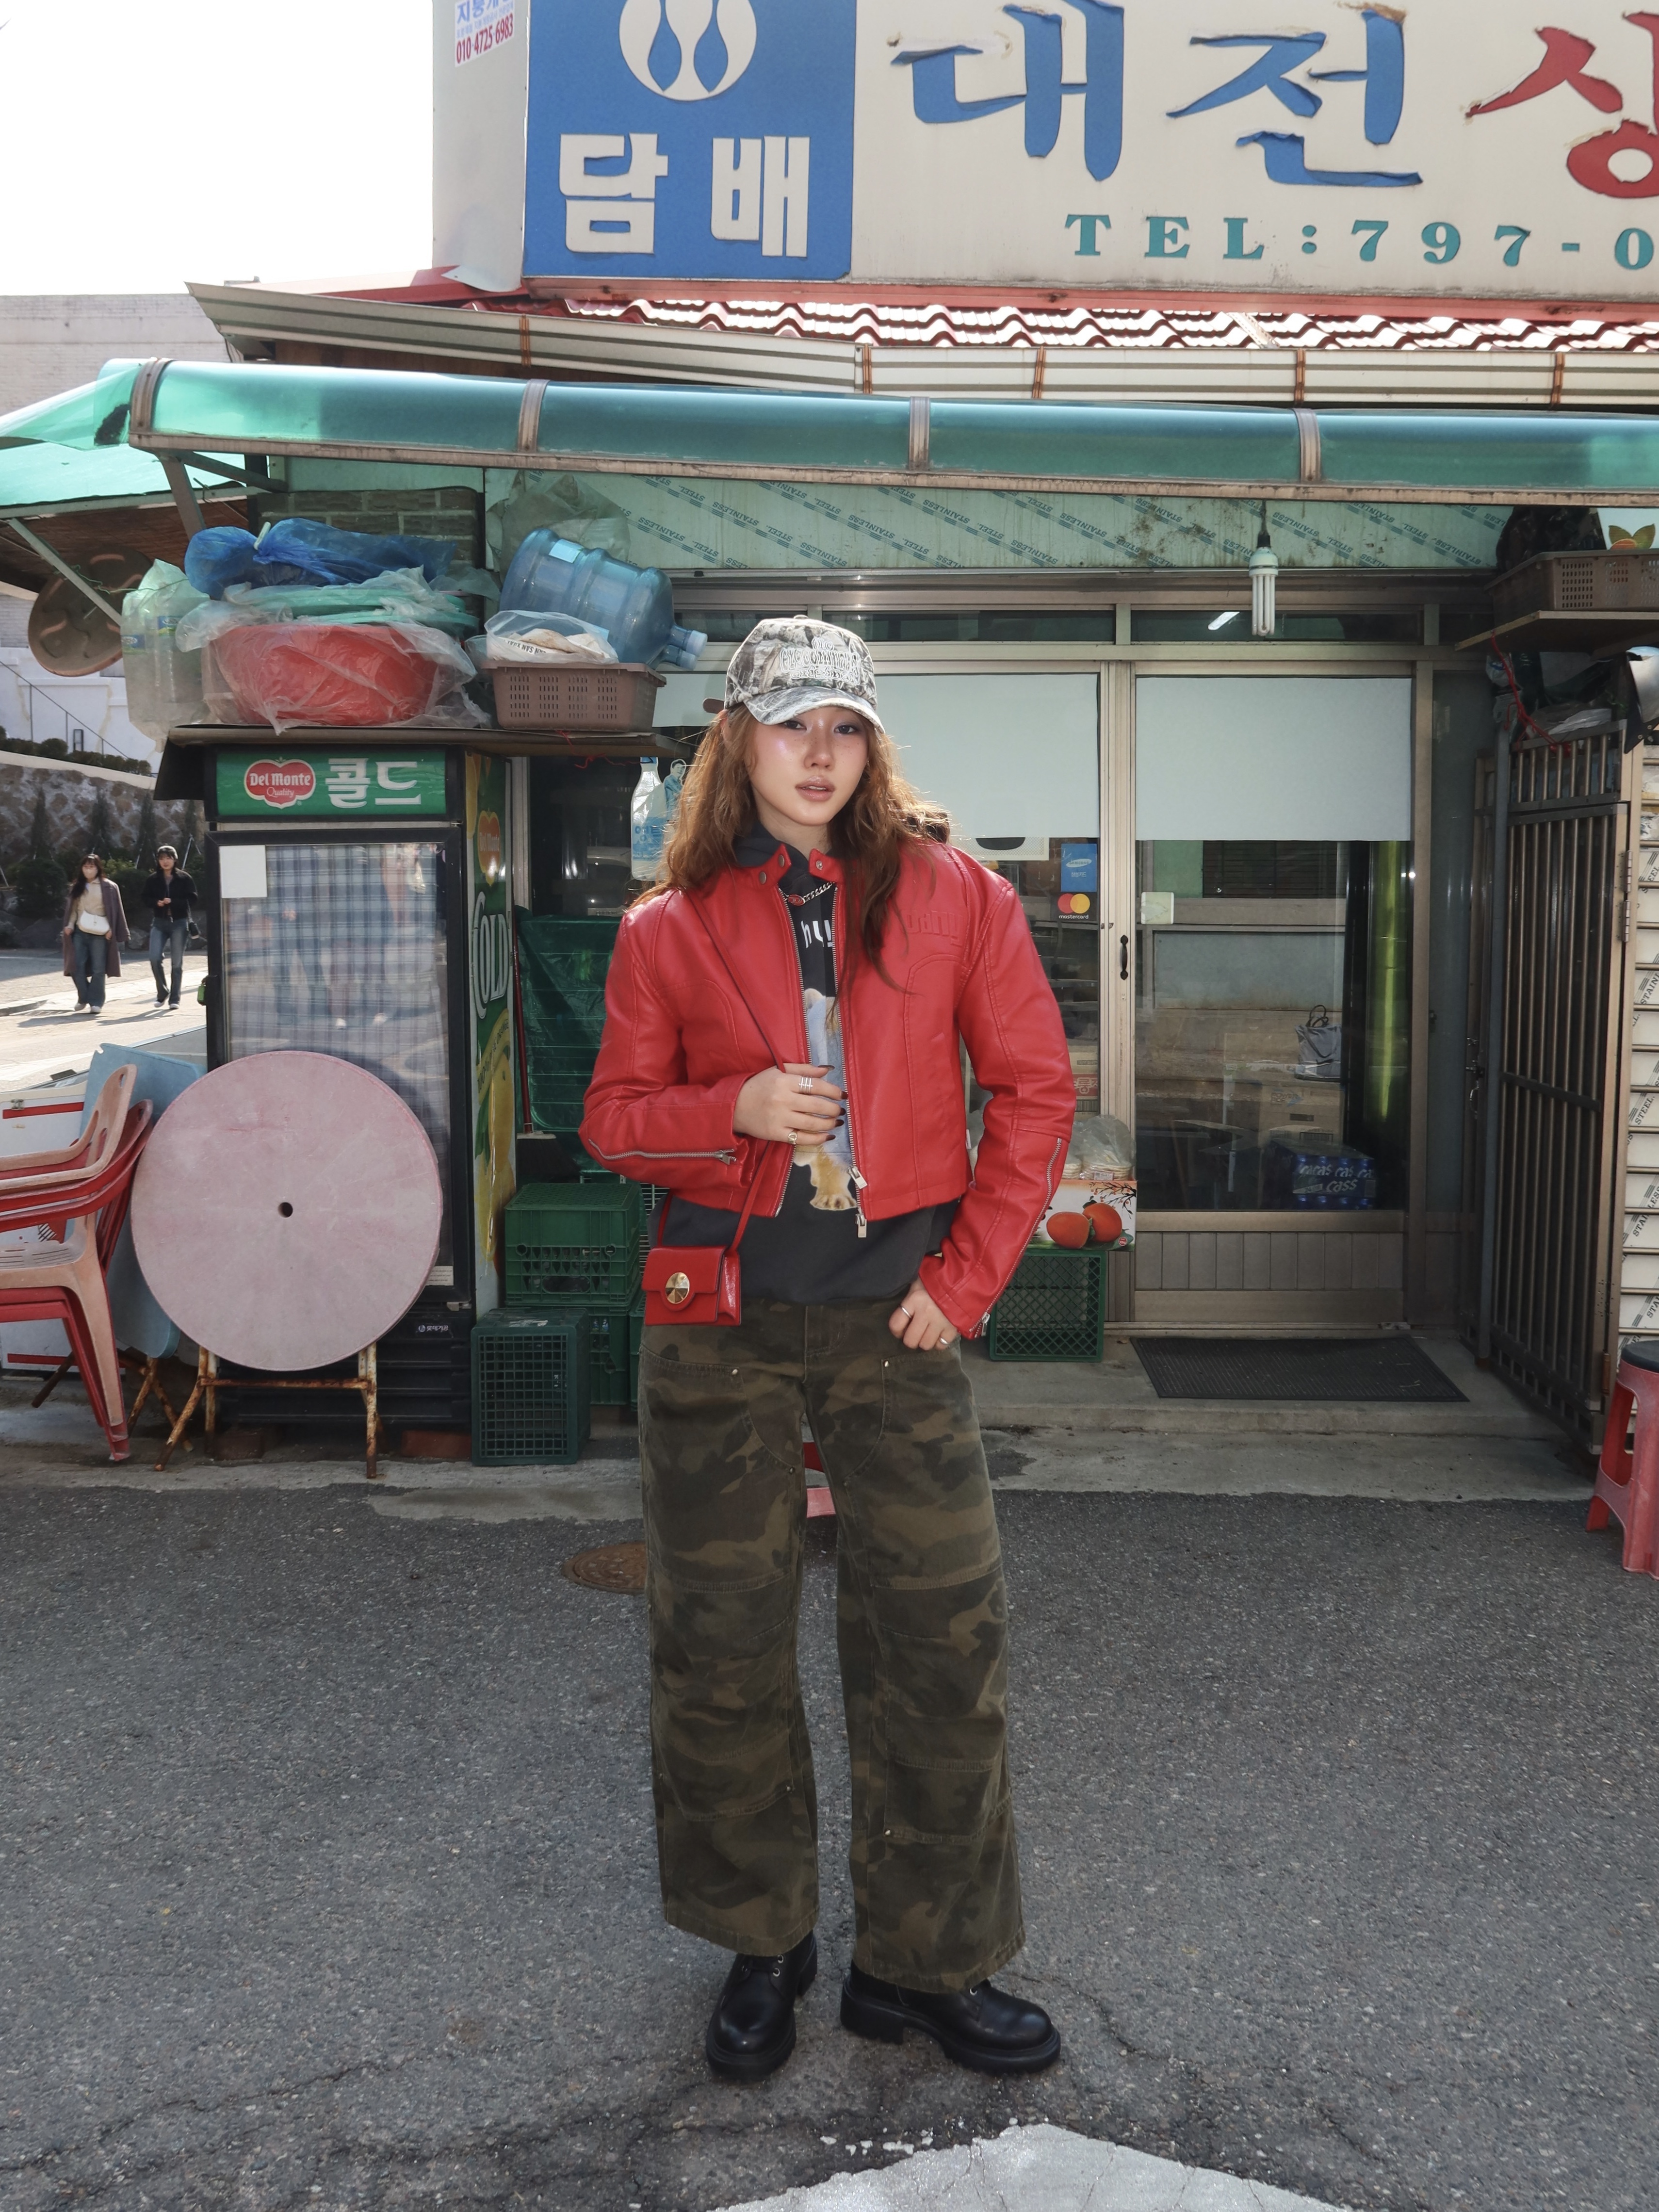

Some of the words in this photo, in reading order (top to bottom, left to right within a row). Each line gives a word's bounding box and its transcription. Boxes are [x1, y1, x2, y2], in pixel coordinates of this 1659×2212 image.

[559, 133, 810, 258] 담배
[679, 485, 705, 502] STEEL.
[1025, 496, 1053, 513] STEEL.
[713, 502, 759, 526] STAINLESS
[814, 498, 842, 514] STEEL.
[923, 499, 970, 524] STAINLESS
[638, 517, 685, 542] STAINLESS
[766, 525, 793, 542] STEEL.
[848, 515, 896, 539] STAINLESS
[977, 523, 1004, 539] STEEL.
[1060, 513, 1107, 537] STAINLESS
[1272, 512, 1319, 537] STAINLESS
[692, 540, 719, 557] STEEL.
[800, 542, 847, 567] STAINLESS
[902, 538, 929, 555] STEEL.
[1011, 540, 1058, 565] STAINLESS
[1435, 539, 1481, 565] STAINLESS
[250, 773, 269, 786] Del
[271, 772, 311, 787] Monte
[325, 758, 421, 809] 콜드
[266, 787, 294, 798] Quality
[472, 892, 509, 1020] COLD
[1635, 1096, 1655, 1125] STEEL.
